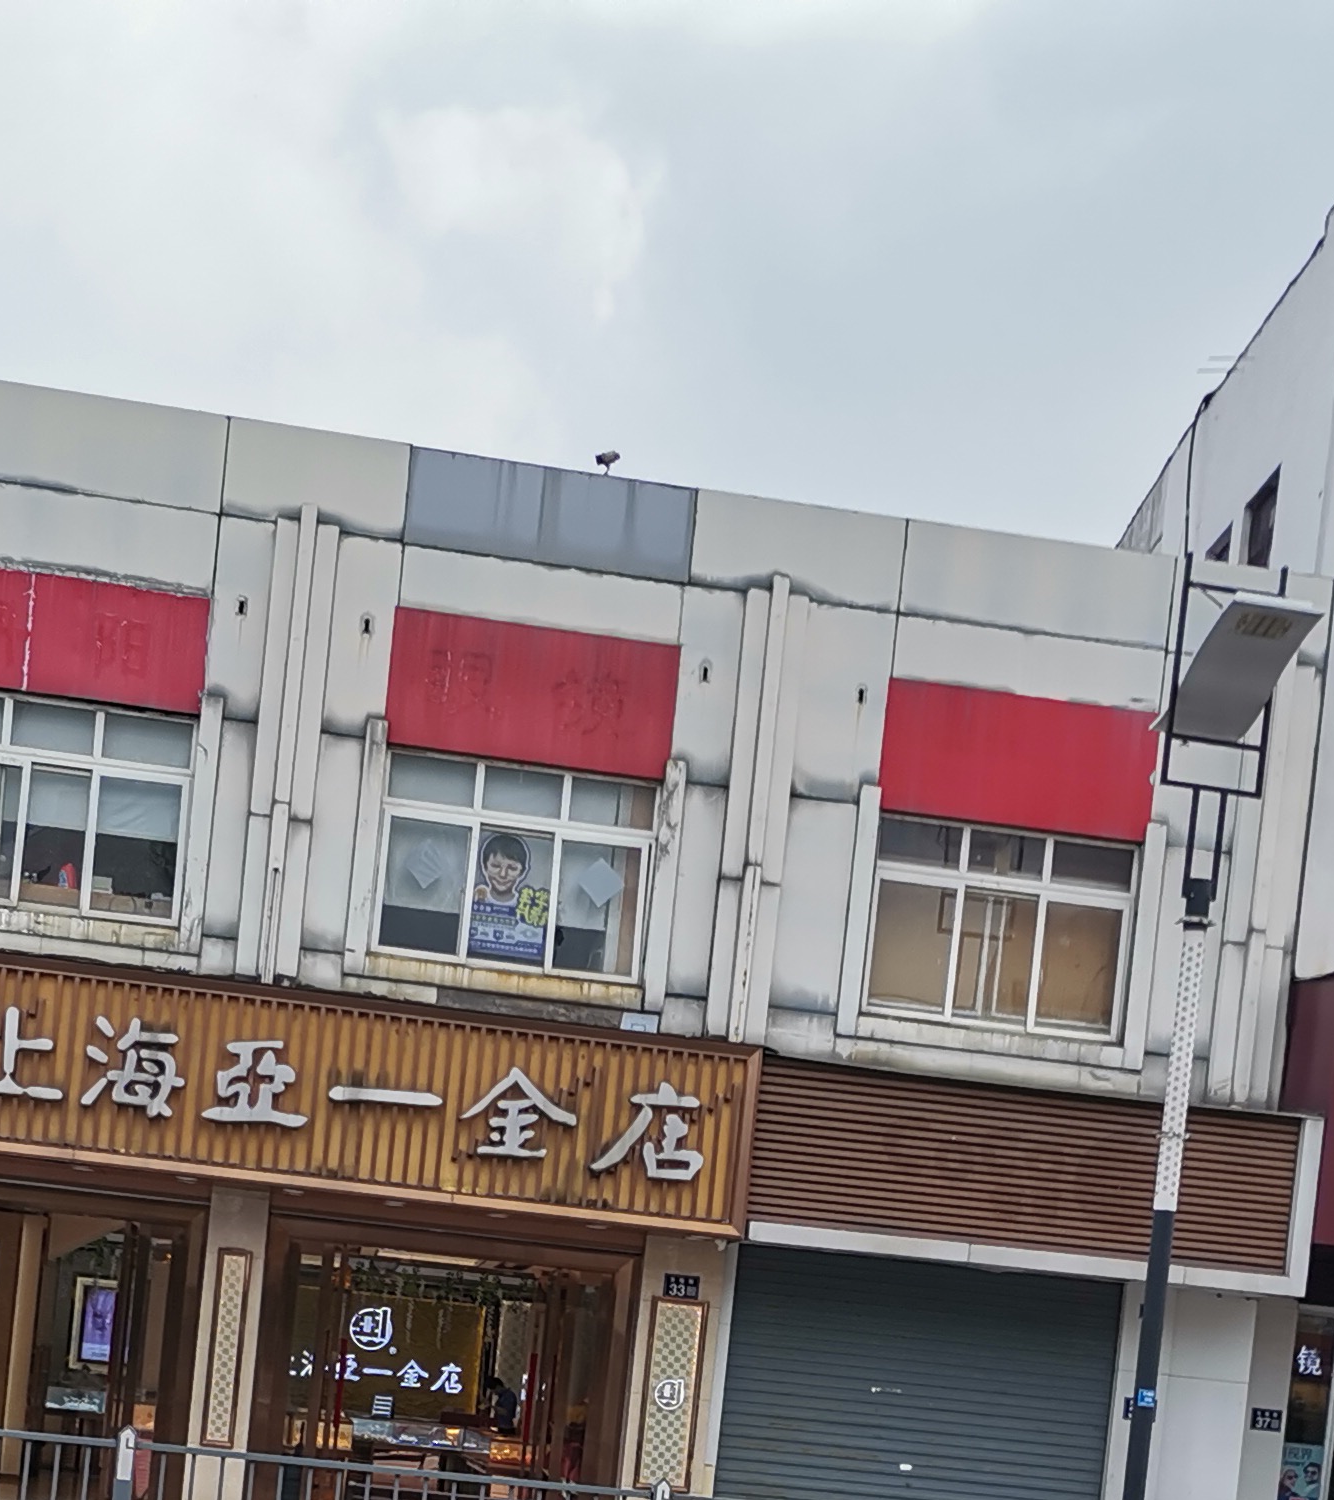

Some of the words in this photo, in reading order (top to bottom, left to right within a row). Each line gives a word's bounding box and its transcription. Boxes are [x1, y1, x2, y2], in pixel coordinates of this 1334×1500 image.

[668, 1283, 686, 1297] 33
[1296, 1344, 1323, 1377] 镜
[1255, 1416, 1272, 1429] 37
